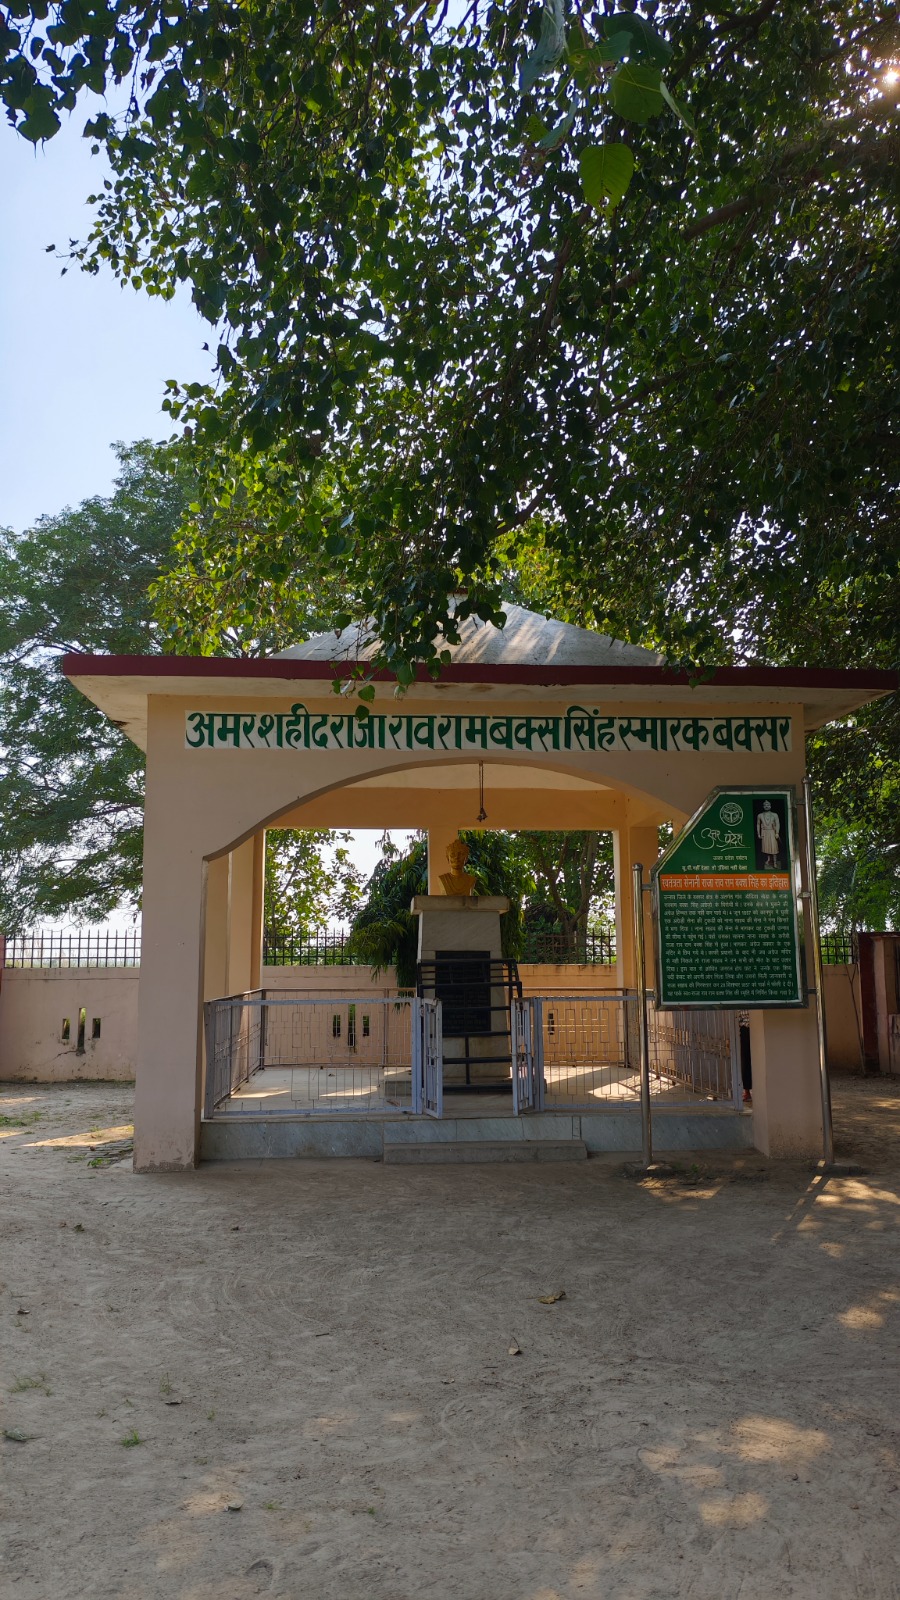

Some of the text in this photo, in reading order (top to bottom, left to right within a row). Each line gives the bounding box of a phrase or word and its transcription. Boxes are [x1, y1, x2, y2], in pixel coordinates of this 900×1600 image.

[185, 703, 791, 751] अमर शहीद राजा राव राम बक्स सिंह स्मारक बक्सर
[692, 827, 721, 850] उत्तर
[661, 876, 682, 888] स्वतंत्रता
[683, 874, 700, 888] सेनानी
[701, 878, 714, 888] राजा
[714, 878, 723, 888] राव
[724, 878, 734, 888] राम
[748, 874, 759, 889] सिंह
[760, 878, 767, 888] का
[768, 874, 788, 889] इतिहास
